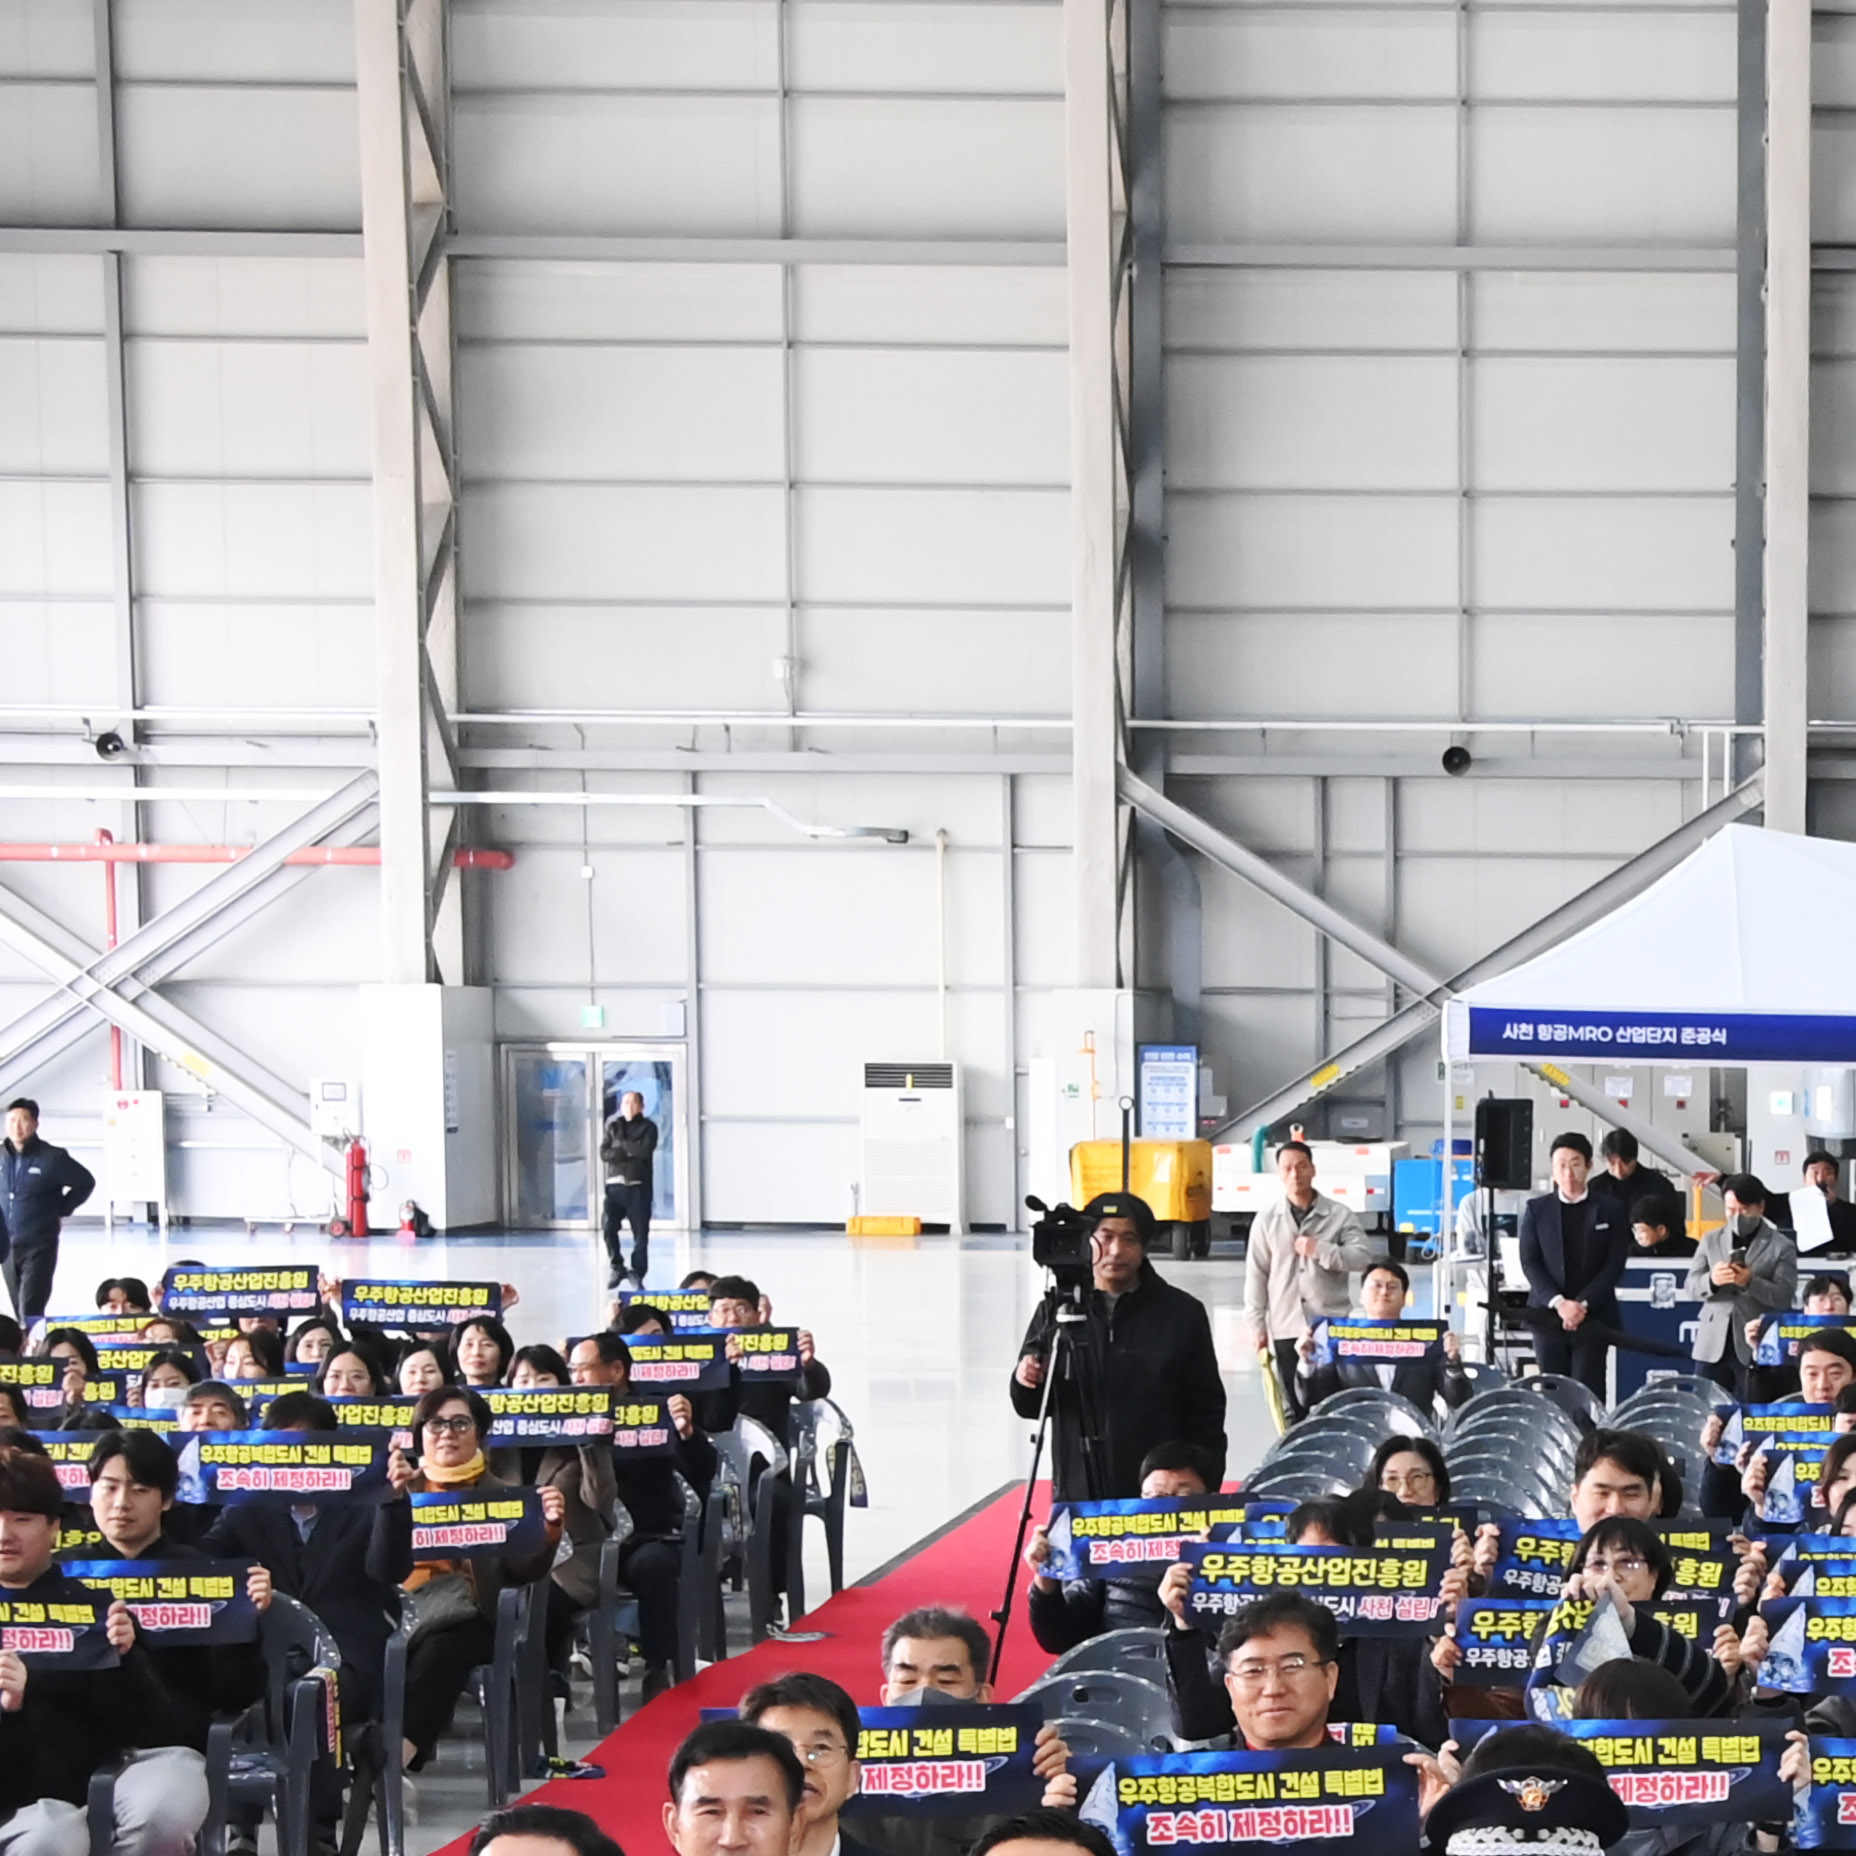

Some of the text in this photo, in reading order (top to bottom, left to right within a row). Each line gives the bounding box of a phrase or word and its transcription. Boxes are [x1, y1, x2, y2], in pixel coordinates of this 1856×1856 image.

[1502, 1022, 1727, 1045] 사천 항공MRO 산업단지 준공식
[173, 1271, 309, 1291] 우주항공산업진흥원
[353, 1285, 489, 1306] 우주항공산업진흥원
[487, 1393, 608, 1414] 항공산업진흥원
[200, 1444, 302, 1465] 우주항공복합도시
[304, 1445, 332, 1464] 건설
[217, 1467, 352, 1491] 조속히 제정하라!!
[429, 1520, 506, 1548] 제정하라!!
[1071, 1512, 1176, 1537] 우주항공복합도시
[1089, 1539, 1142, 1563] 조속히
[1200, 1555, 1428, 1588] 우주항공산업진흥원
[157, 1576, 234, 1598] 건설 특별법
[13, 1603, 95, 1624] 건설 특별법
[1358, 1596, 1442, 1620] 사천 설립!
[1, 1628, 74, 1652] 정하라!!
[912, 1727, 1017, 1756] 건설 특별법
[1658, 1736, 1760, 1764] 건설 특별법
[860, 1760, 986, 1795] 제정하라!!
[1119, 1769, 1384, 1805] 우주항공복합도시 건설 특별법
[1608, 1772, 1730, 1804] 제정하라!!
[1146, 1806, 1355, 1845] 조속히 제정하라!!
